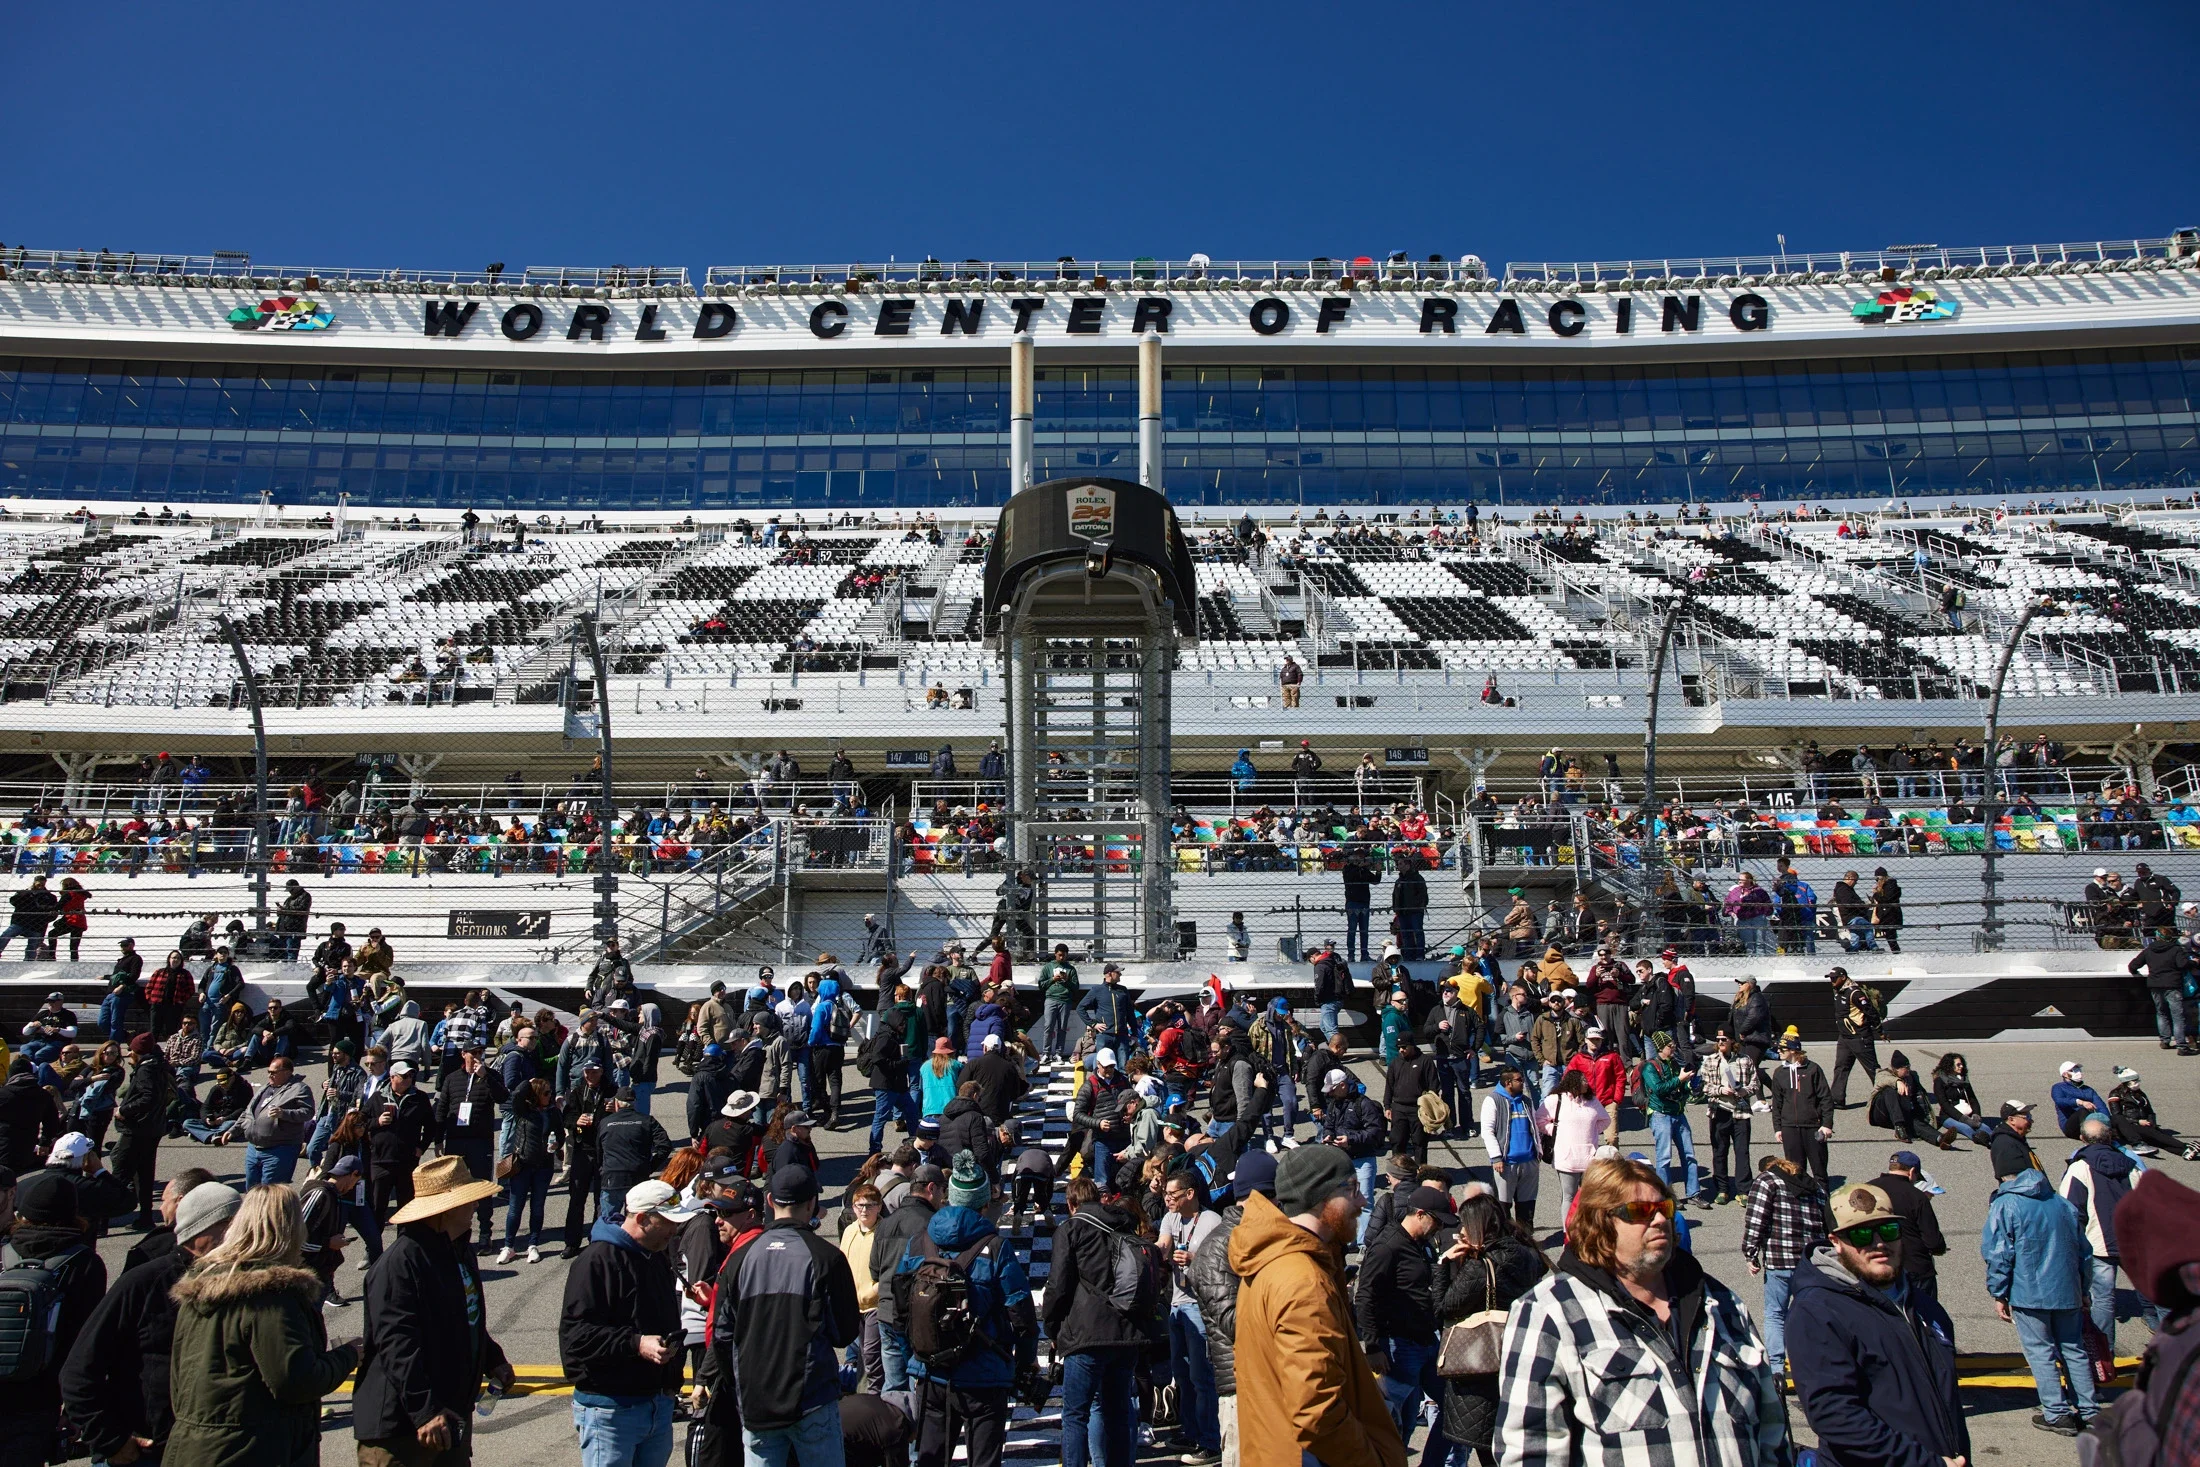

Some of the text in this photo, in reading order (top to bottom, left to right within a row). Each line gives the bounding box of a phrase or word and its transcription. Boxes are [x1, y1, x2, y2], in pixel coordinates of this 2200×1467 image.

[424, 294, 1769, 341] WORLD CENTER OF RACING
[1071, 505, 1112, 520] 24
[583, 521, 594, 532] L4
[843, 518, 854, 528] L3
[820, 551, 832, 561] 52
[1401, 548, 1419, 559] 350
[532, 554, 550, 566] 353
[1976, 560, 1996, 571] 348
[80, 567, 101, 580] 354
[359, 754, 395, 763] 148 147
[890, 753, 928, 762] 147 146
[1389, 750, 1426, 759] 146 145
[1766, 792, 1795, 814] 145
[456, 912, 475, 924] ALL
[455, 925, 508, 936] SECTIONS
